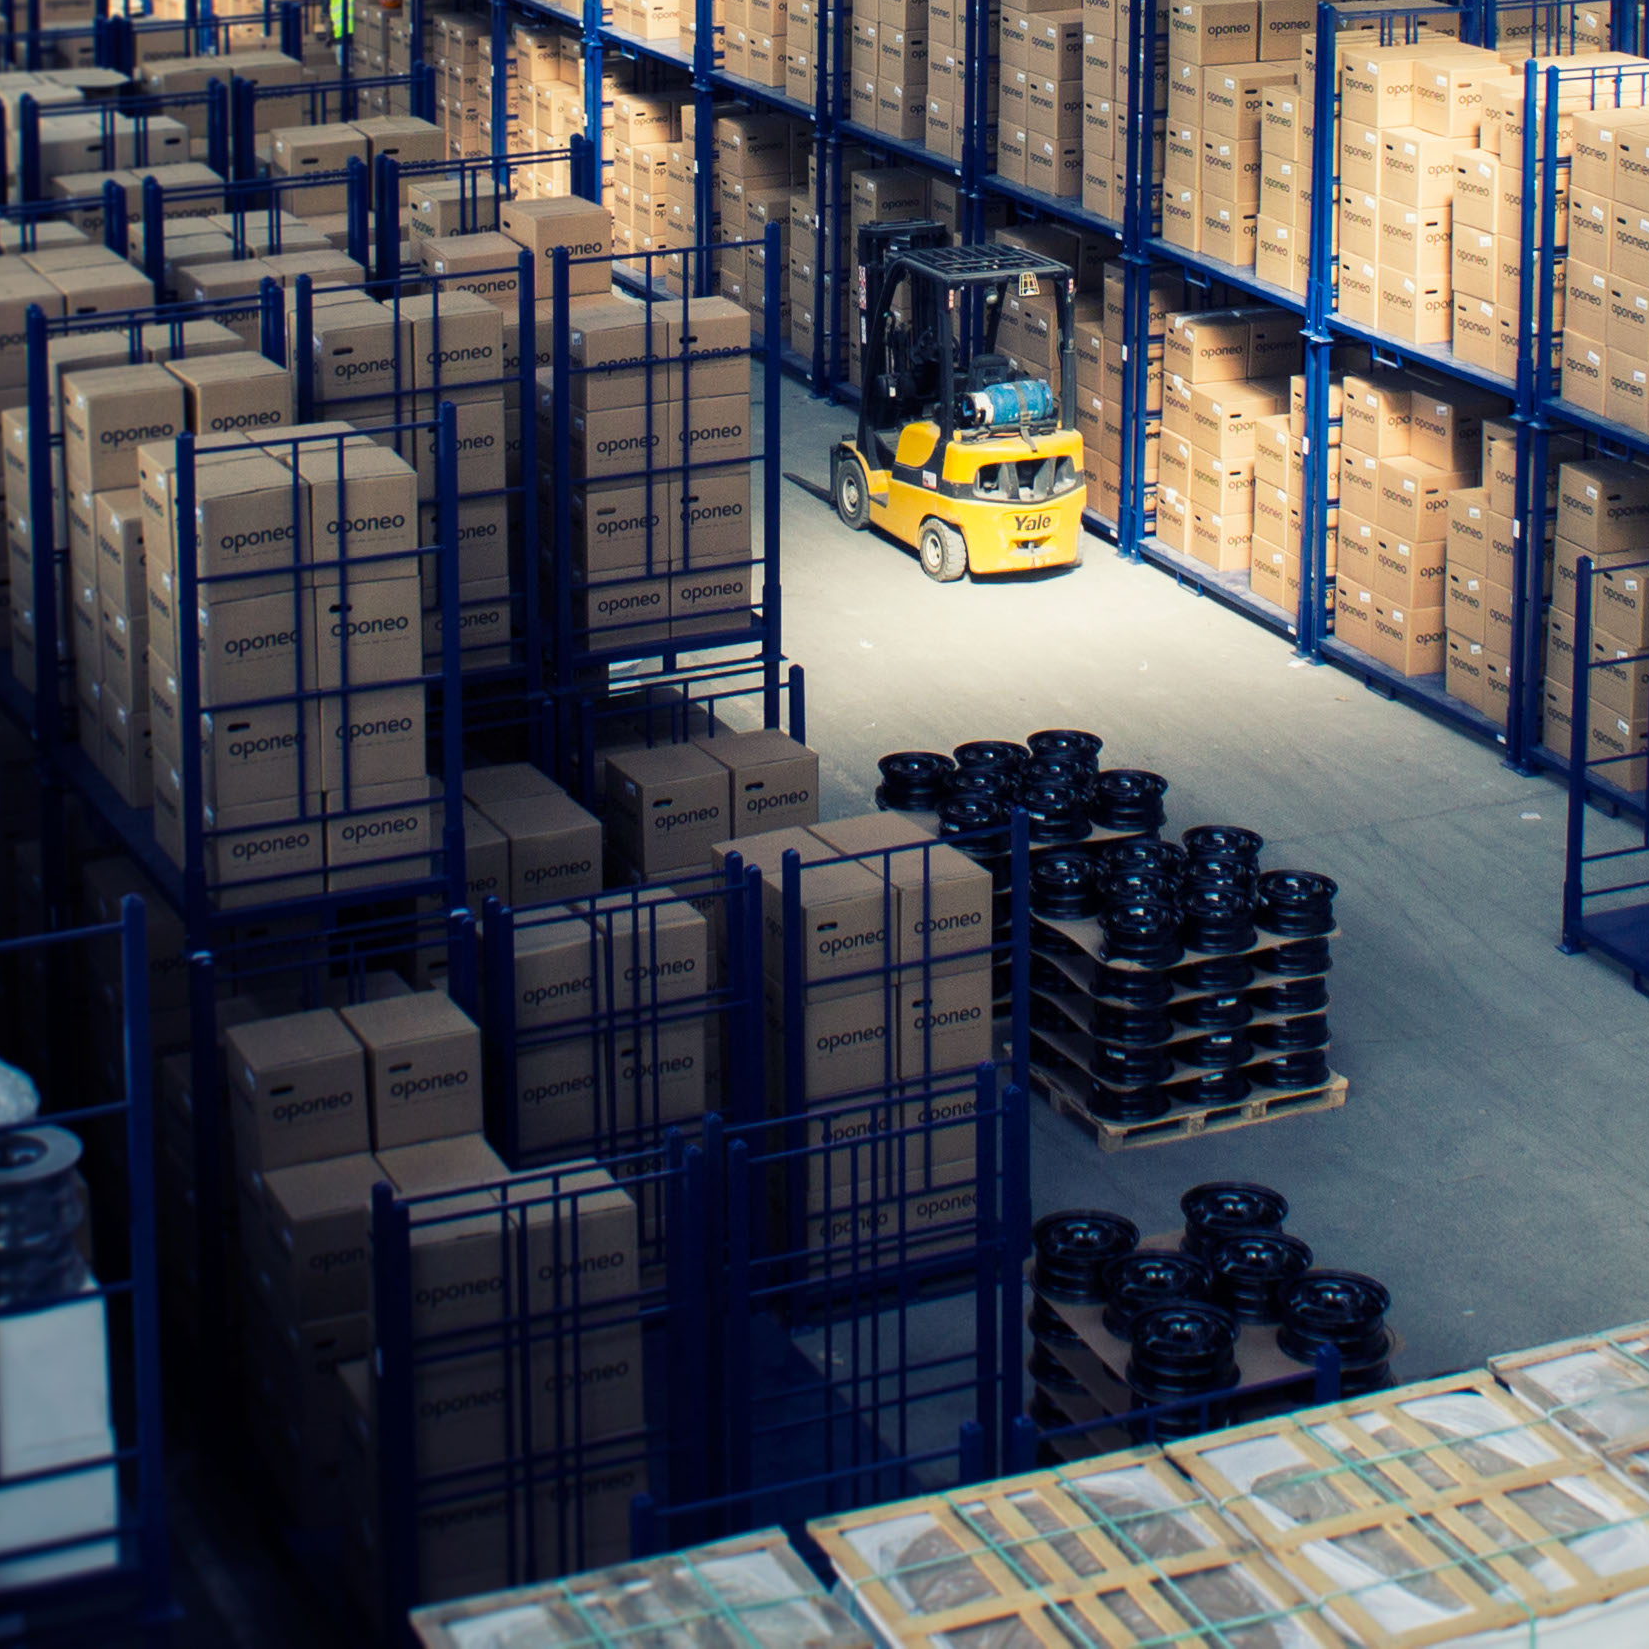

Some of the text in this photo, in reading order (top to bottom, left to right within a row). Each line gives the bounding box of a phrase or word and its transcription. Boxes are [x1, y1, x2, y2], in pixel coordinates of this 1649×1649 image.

[931, 6, 950, 19] oponeo
[1002, 27, 1025, 42] oponeo
[1173, 19, 1196, 34] oponeo
[1208, 23, 1250, 37] oponeo
[1270, 20, 1310, 32] oponeo
[1031, 35, 1055, 51] oponeo
[1086, 55, 1108, 69] oponeo
[1002, 84, 1023, 99] oponeo
[1171, 80, 1196, 96] oponeo
[1346, 75, 1373, 93] oponeo
[1417, 85, 1446, 102] oponeo
[1030, 94, 1053, 110] oponeo
[1207, 91, 1233, 108] oponeo
[928, 114, 948, 130] oponeo
[1085, 115, 1108, 130] oponeo
[1266, 112, 1292, 128] oponeo
[1000, 139, 1022, 156] oponeo
[1169, 142, 1193, 158] oponeo
[1344, 143, 1372, 160] oponeo
[1576, 142, 1607, 162] oponeo
[1030, 152, 1052, 168] oponeo
[1205, 154, 1232, 171] oponeo
[1385, 156, 1414, 173] oponeo
[1085, 172, 1107, 189] oponeo
[1264, 175, 1290, 193] oponeo
[1457, 180, 1489, 197] oponeo
[1166, 203, 1191, 220] oponeo
[1344, 209, 1372, 227] oponeo
[1205, 215, 1230, 234] oponeo
[1383, 223, 1412, 241] oponeo
[1573, 214, 1604, 235] oponeo
[1261, 239, 1288, 257] oponeo
[1616, 229, 1649, 251] oponeo
[1457, 248, 1488, 267] oponeo
[1342, 275, 1371, 293] oponeo
[1383, 291, 1412, 309] oponeo
[1570, 285, 1601, 307] oponeo
[1611, 302, 1645, 324] oponeo
[1458, 319, 1491, 336] oponeo
[1167, 338, 1191, 356] oponeo
[1201, 345, 1242, 358] oponeo
[1566, 356, 1598, 378] oponeo
[1611, 375, 1643, 396] oponeo
[1165, 395, 1189, 413] oponeo
[1347, 404, 1375, 424] oponeo
[212, 411, 281, 433] oponeo
[1194, 413, 1218, 431] oponeo
[1414, 415, 1446, 436] oponeo
[102, 423, 174, 447] oponeo
[597, 434, 660, 455] oponeo
[679, 426, 742, 444] oponeo
[1162, 451, 1186, 470] oponeo
[1258, 443, 1283, 462] oponeo
[1194, 469, 1219, 488] oponeo
[1344, 468, 1372, 489] oponeo
[1382, 486, 1412, 507] oponeo
[1563, 493, 1594, 517] oponeo
[680, 503, 742, 523] oponeo
[1159, 508, 1182, 527] oponeo
[1257, 501, 1283, 521] oponeo
[327, 514, 405, 535] oponeo
[597, 515, 659, 537] oponeo
[1014, 515, 1051, 532] Yale
[1193, 524, 1218, 542] oponeo
[1452, 518, 1482, 540] oponeo
[221, 525, 296, 552] oponeo
[1342, 536, 1368, 556] oponeo
[1254, 557, 1280, 578] oponeo
[1378, 553, 1407, 575] oponeo
[681, 581, 743, 603] oponeo
[1450, 588, 1479, 608] oponeo
[1603, 585, 1635, 609] oponeo
[598, 592, 660, 615] oponeo
[1338, 601, 1368, 621] oponeo
[331, 616, 408, 637] oponeo
[1375, 620, 1404, 643] oponeo
[1450, 654, 1480, 678] oponeo
[335, 717, 412, 739] oponeo
[1593, 728, 1625, 752] oponeo
[746, 790, 808, 813] oponeo
[655, 804, 719, 828] oponeo
[342, 817, 418, 842] oponeo
[232, 833, 310, 859] oponeo
[524, 859, 591, 883] oponeo
[914, 912, 982, 934] oponeo
[820, 929, 887, 956] oponeo
[523, 977, 594, 1006] oponeo
[914, 1006, 981, 1029] oponeo
[817, 1025, 887, 1052] oponeo
[391, 1071, 468, 1100] oponeo
[523, 1075, 595, 1104] oponeo
[273, 1091, 353, 1123] oponeo
[310, 1246, 365, 1272] opon
[415, 1275, 506, 1308] oponeo
